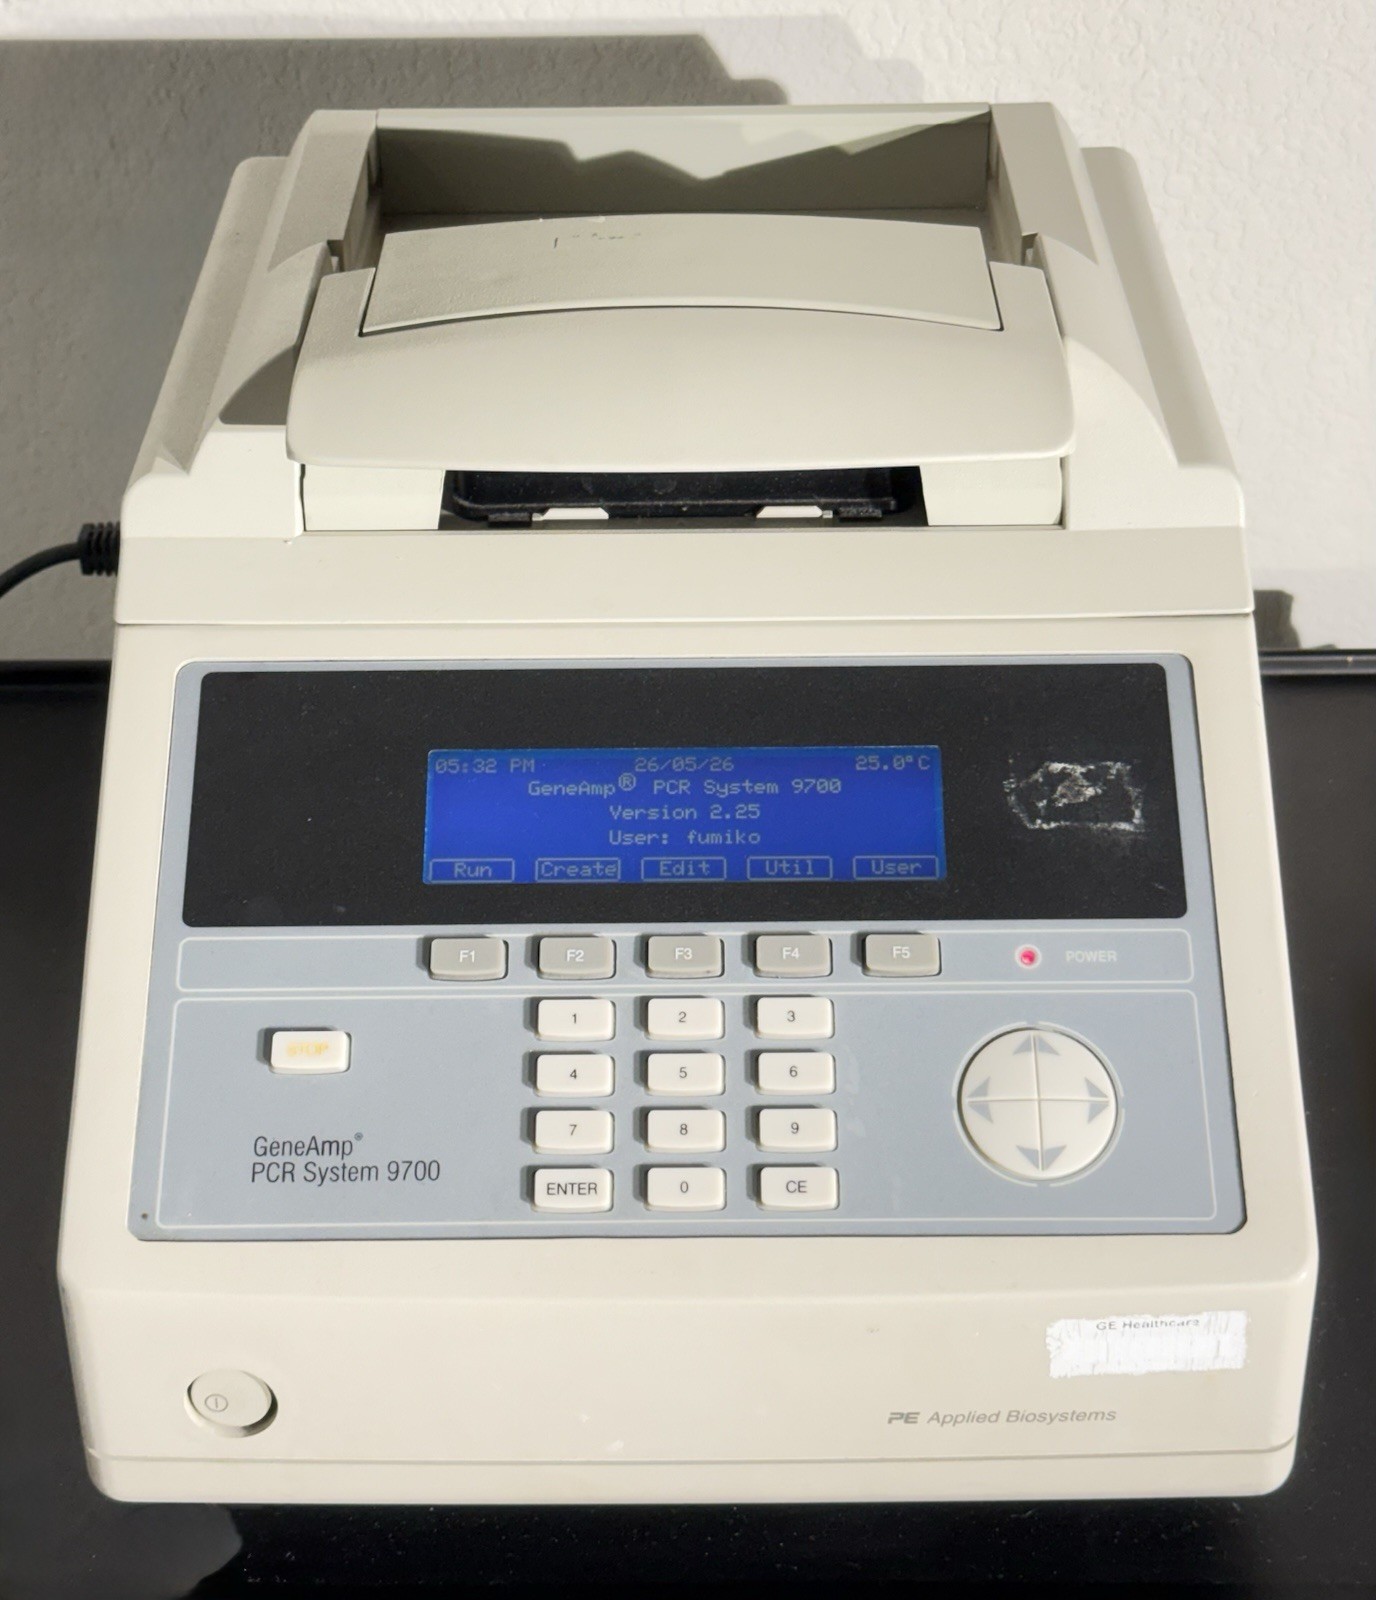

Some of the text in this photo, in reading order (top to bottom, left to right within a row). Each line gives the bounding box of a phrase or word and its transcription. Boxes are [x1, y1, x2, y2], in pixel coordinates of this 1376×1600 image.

[435, 758, 535, 774] 05:32 PM
[634, 757, 735, 773] 26/05/26
[653, 780, 691, 795] PCR
[704, 779, 779, 798] System
[791, 778, 842, 794] 9700
[609, 804, 761, 821] Version 2.25
[608, 829, 761, 846] User: fumiko
[453, 862, 493, 879] Run
[540, 861, 618, 877] Create
[659, 860, 710, 876] Edit
[765, 860, 815, 876] Util
[871, 859, 922, 875] User
[459, 949, 476, 963] F1
[566, 949, 585, 963] F2
[674, 947, 693, 962] F3
[782, 946, 800, 961] F4
[892, 945, 911, 960] F5
[1065, 949, 1118, 964] POWER
[678, 1010, 688, 1024] 2
[786, 1010, 797, 1023] 3
[568, 1068, 579, 1081] 4
[679, 1066, 689, 1080] 5
[789, 1065, 799, 1079] 6
[568, 1123, 579, 1137] 7
[679, 1123, 690, 1137] 8
[790, 1122, 800, 1136] 9
[251, 1160, 441, 1187] PCR System 9700
[546, 1182, 598, 1197] ENTER
[679, 1180, 690, 1195] 0
[785, 1180, 808, 1195] CE
[1095, 1320, 1118, 1331] GE
[887, 1409, 1117, 1428] PE Applied Biosystems
